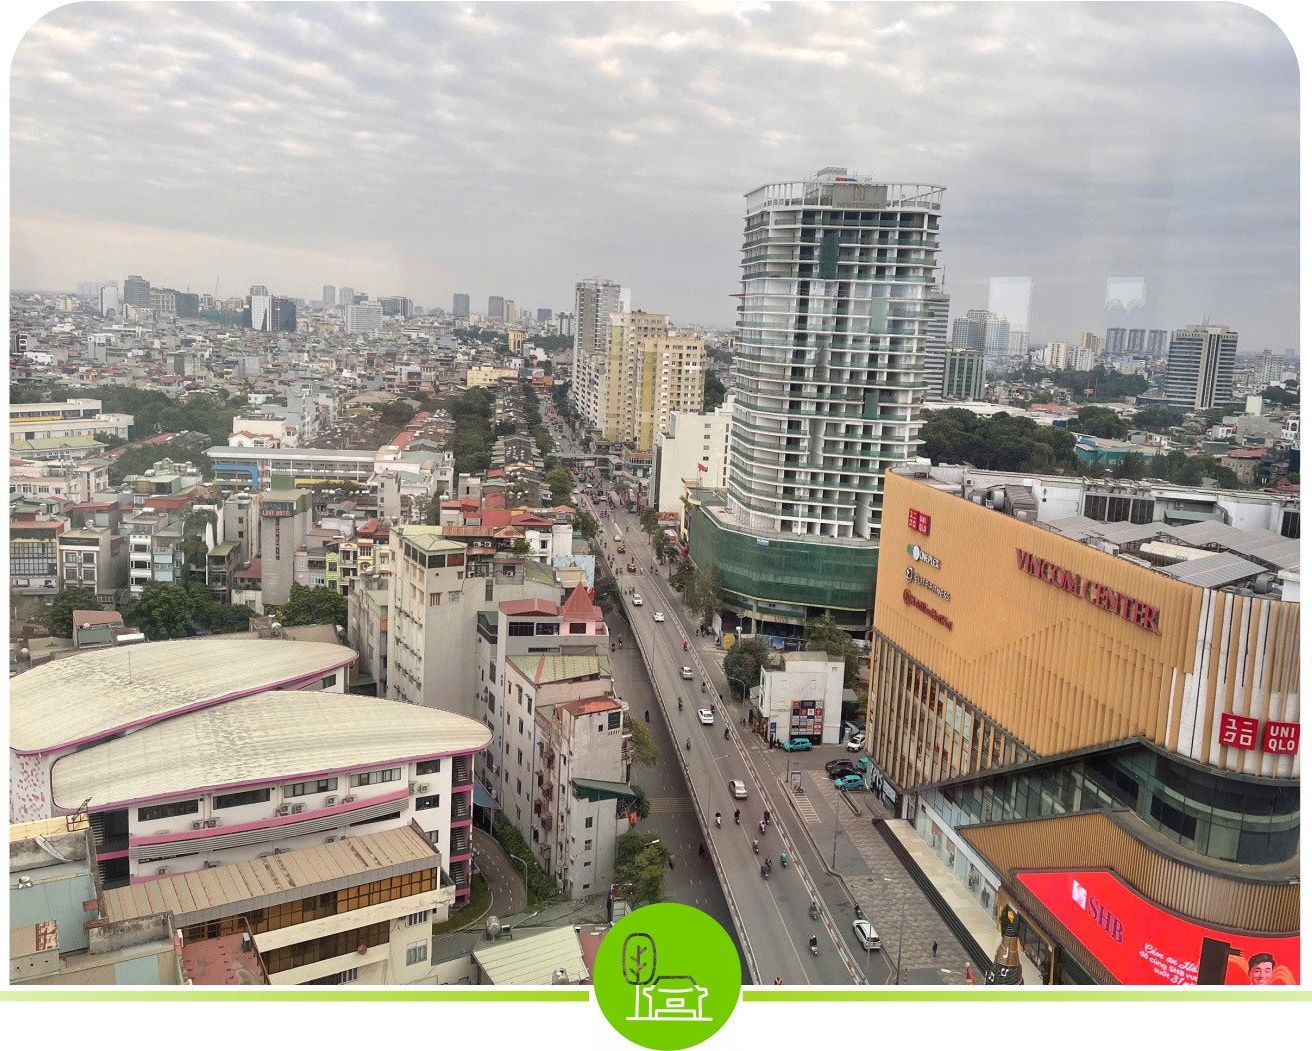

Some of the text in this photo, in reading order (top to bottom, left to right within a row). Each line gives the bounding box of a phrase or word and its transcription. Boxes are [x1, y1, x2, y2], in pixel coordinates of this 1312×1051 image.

[915, 574, 951, 601] ELITE FITNESS
[1015, 547, 1162, 635] VINCOM CENTER
[1270, 725, 1295, 738] UNI
[1268, 738, 1295, 751] QLO
[1088, 896, 1123, 944] SHB
[1169, 965, 1185, 976] SHB
